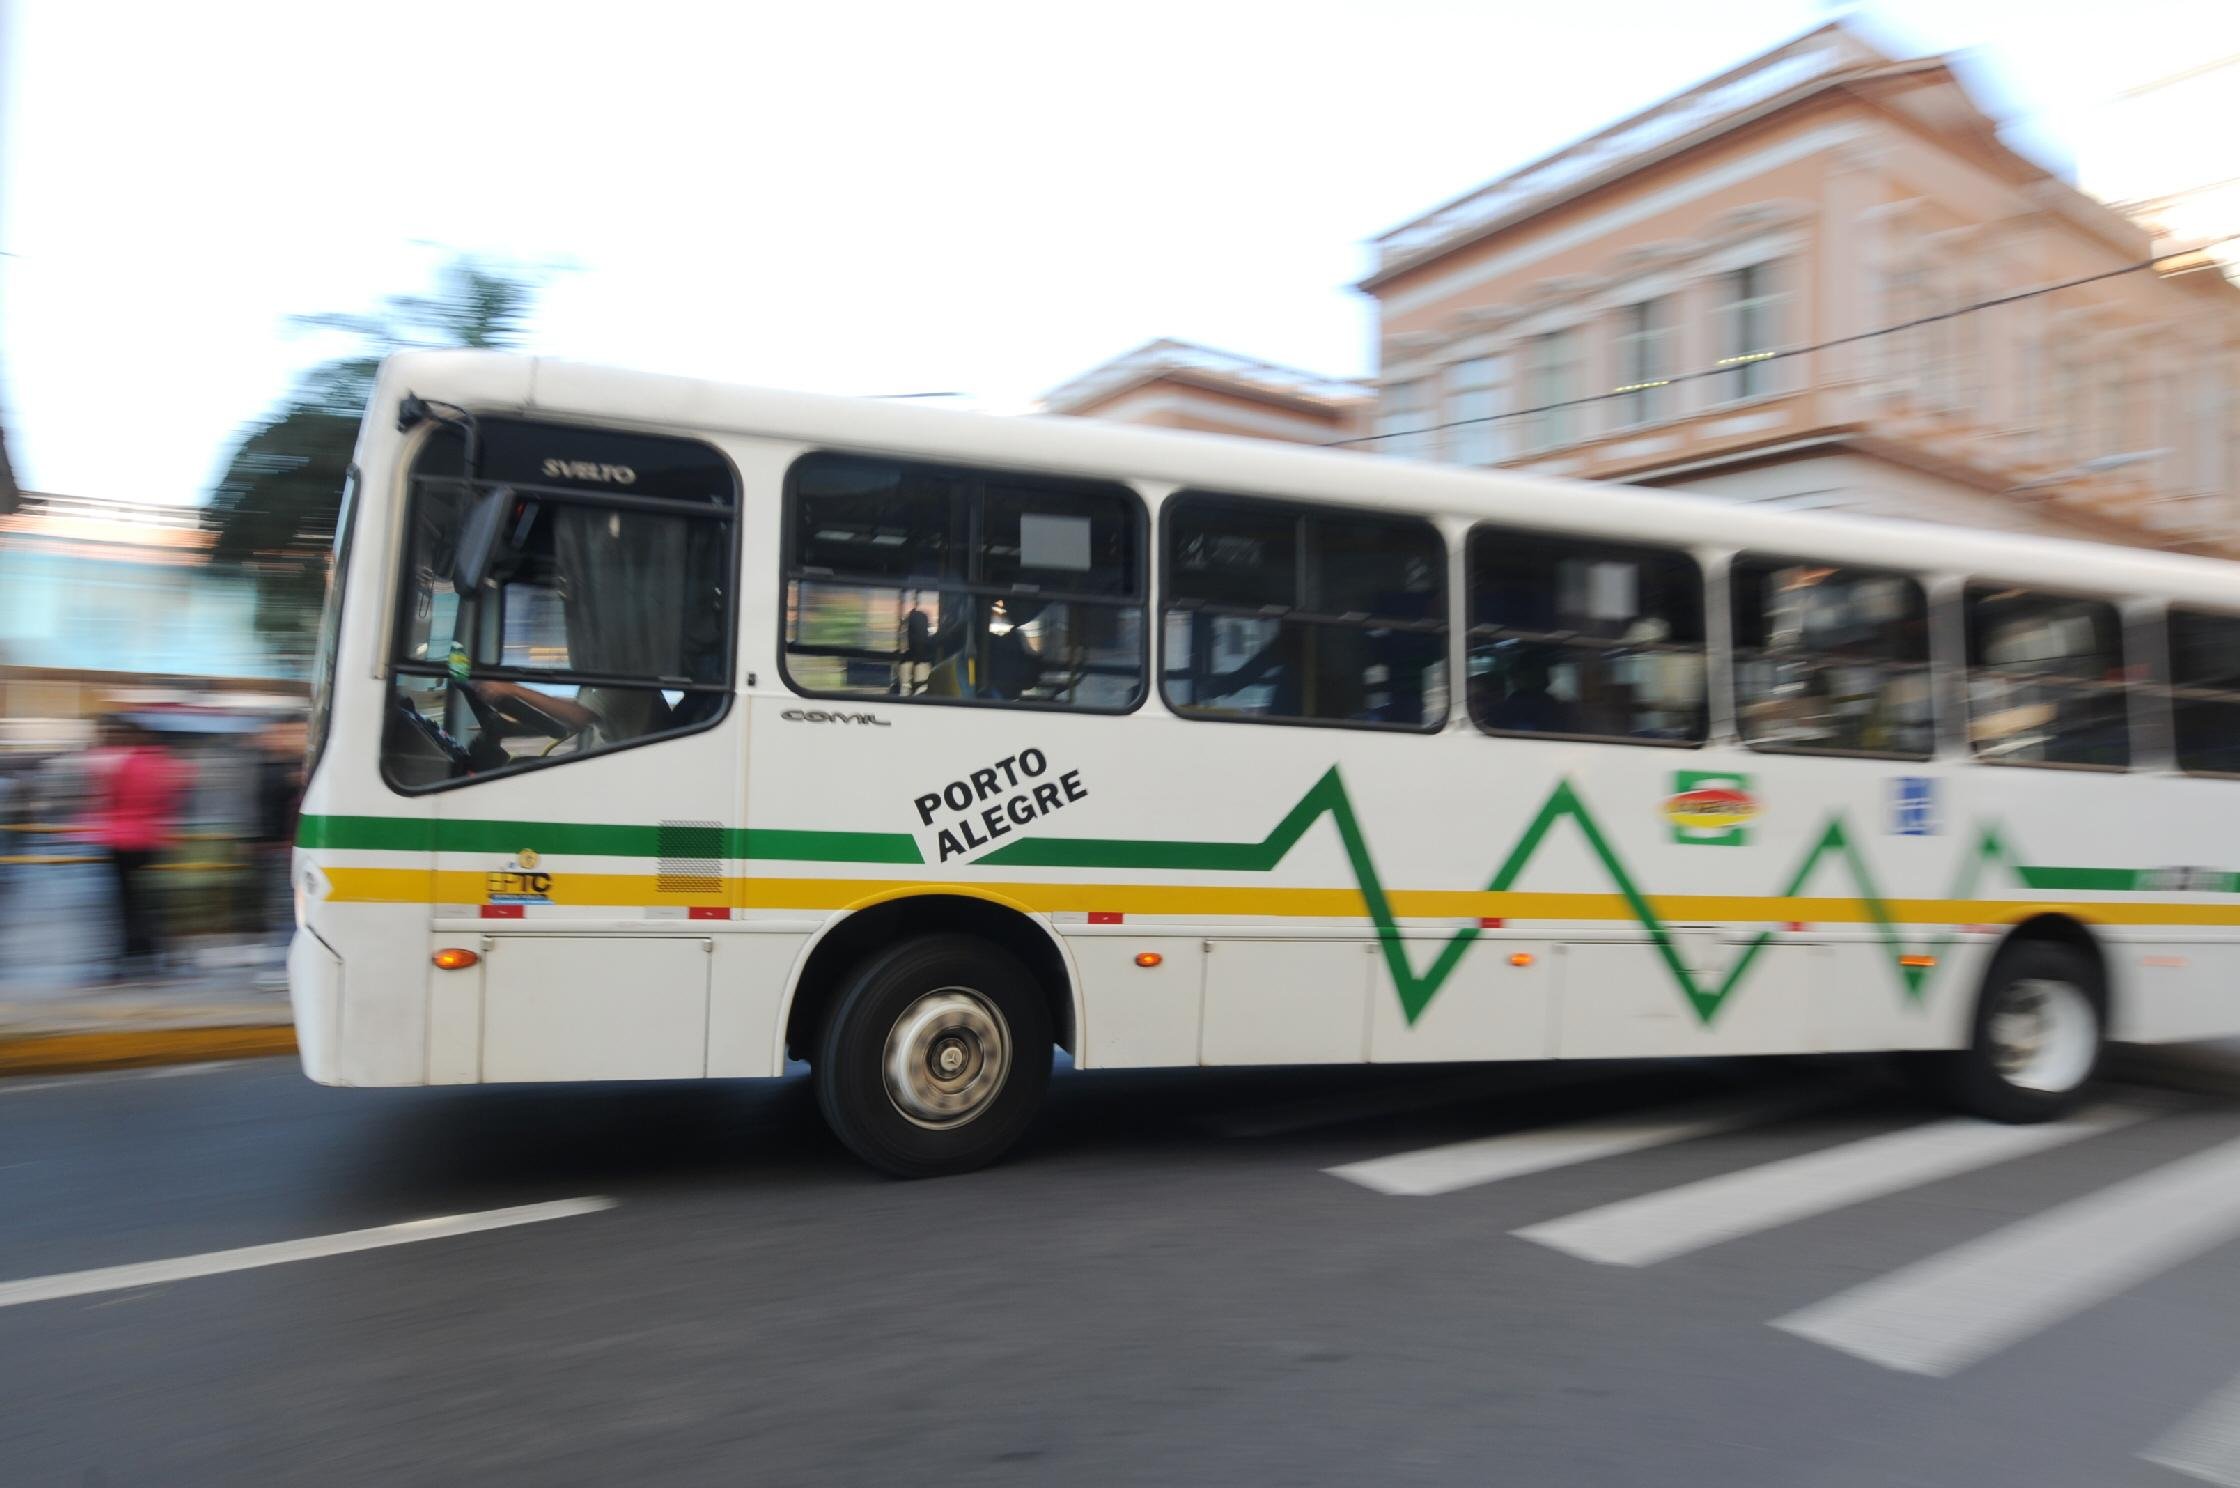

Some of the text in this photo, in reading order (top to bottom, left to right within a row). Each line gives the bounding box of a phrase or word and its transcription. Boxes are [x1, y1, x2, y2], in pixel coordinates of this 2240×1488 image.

[543, 459, 636, 484] SVELTO
[781, 710, 891, 727] COMIL
[914, 748, 1048, 826] PORTO
[938, 769, 1088, 863] ALEGRE
[487, 871, 552, 893] EPTC
